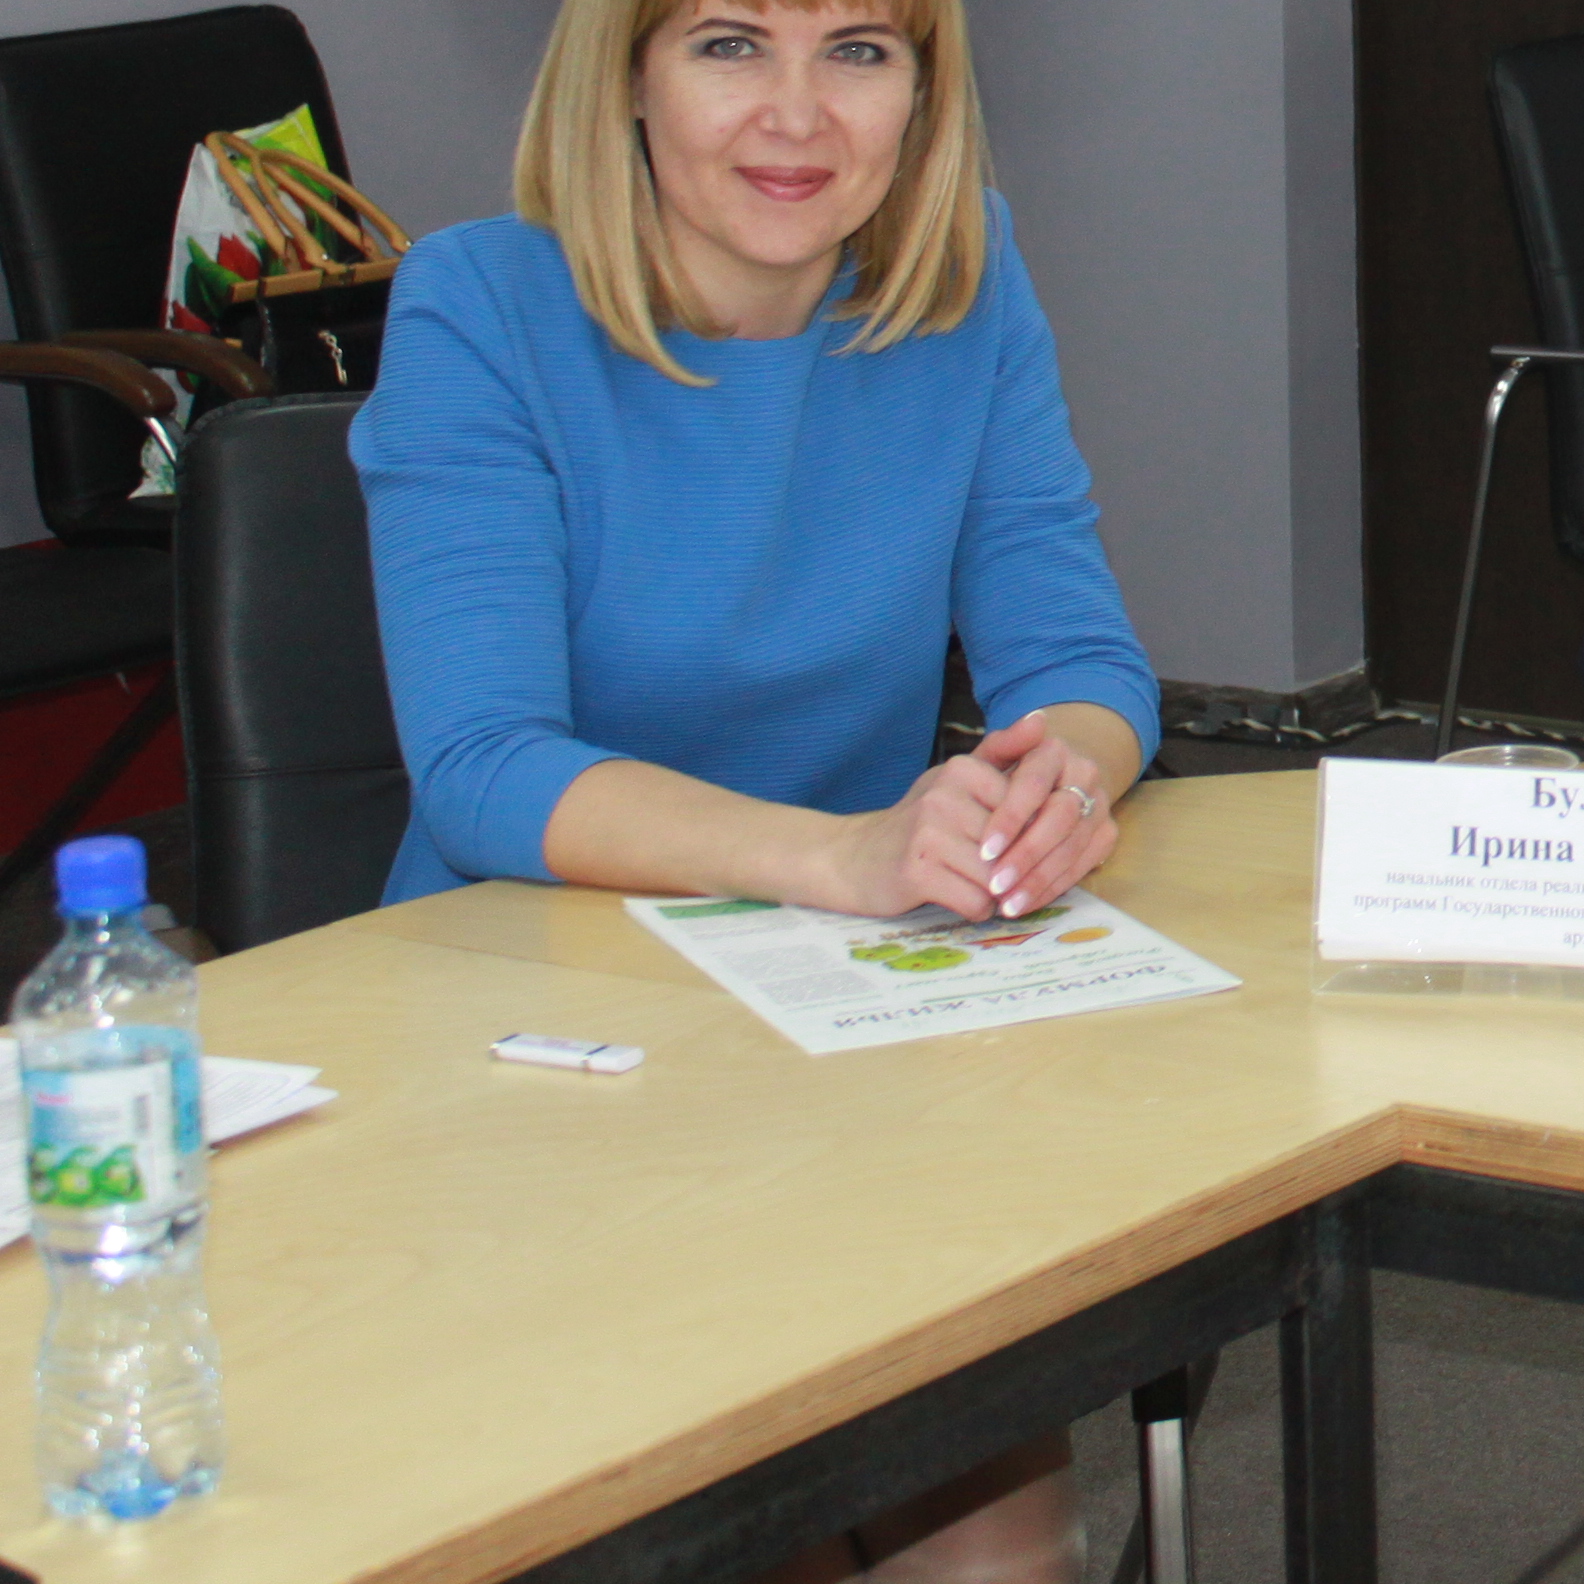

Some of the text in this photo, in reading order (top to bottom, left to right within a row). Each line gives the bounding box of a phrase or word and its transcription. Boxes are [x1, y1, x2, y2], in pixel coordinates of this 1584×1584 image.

[1450, 825, 1575, 869] Ирина
[1386, 871, 1475, 888] начальник
[1480, 876, 1538, 893] отдела
[1354, 892, 1437, 913] программ
